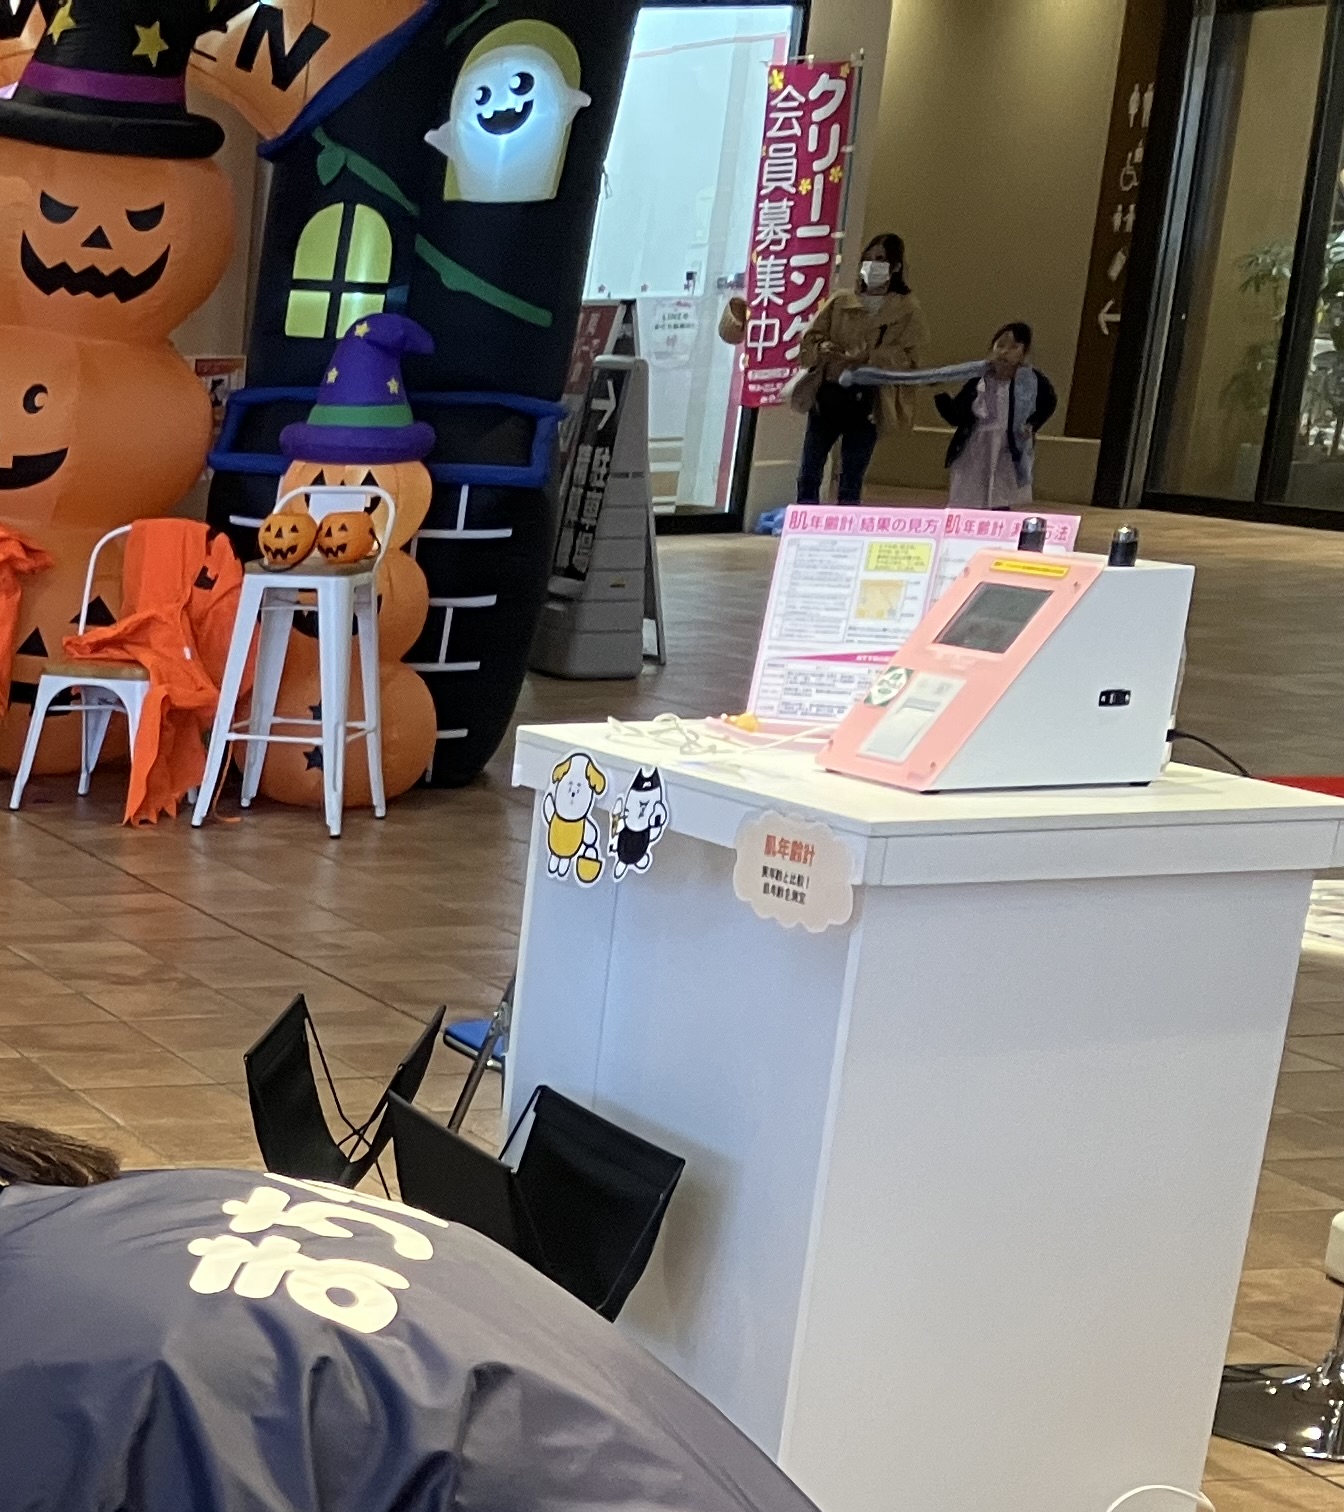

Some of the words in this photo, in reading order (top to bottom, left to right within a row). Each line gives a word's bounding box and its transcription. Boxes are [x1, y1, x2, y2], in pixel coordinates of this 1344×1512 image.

[747, 84, 806, 362] 会員募集中
